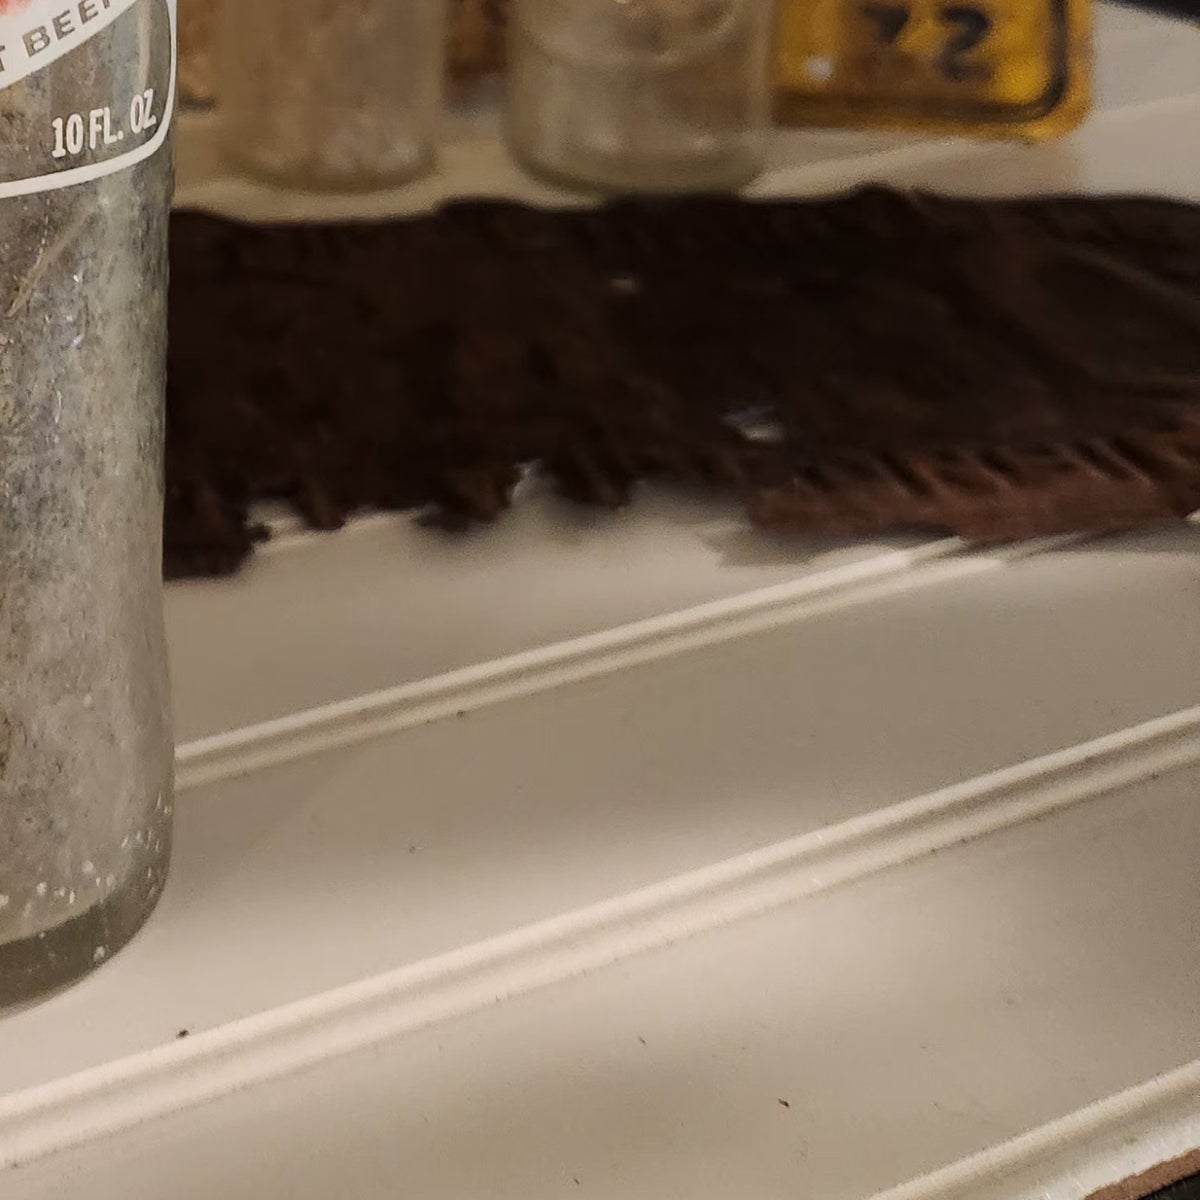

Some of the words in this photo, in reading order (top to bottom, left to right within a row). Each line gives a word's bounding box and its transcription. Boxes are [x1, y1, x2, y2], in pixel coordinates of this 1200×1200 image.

[51, 115, 84, 159] 10
[88, 107, 124, 151] FL.
[130, 88, 157, 134] OZ
